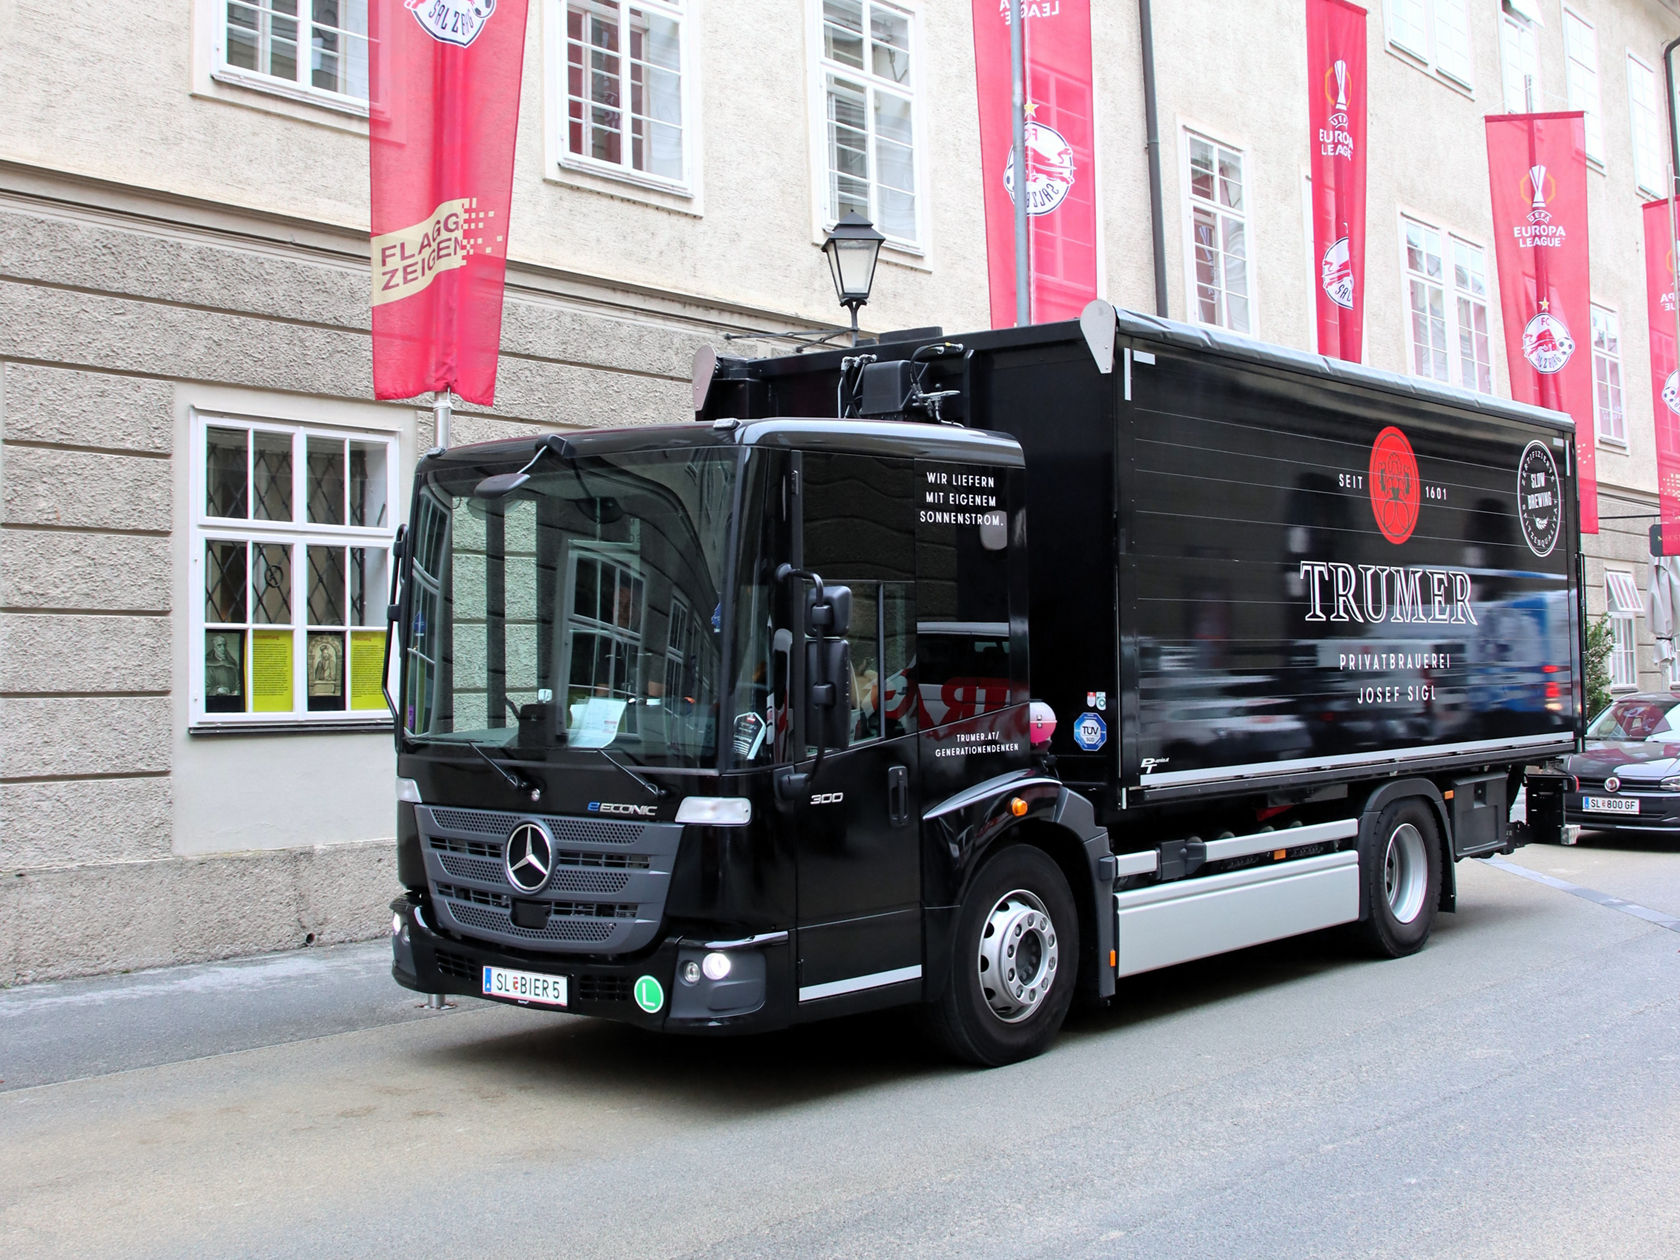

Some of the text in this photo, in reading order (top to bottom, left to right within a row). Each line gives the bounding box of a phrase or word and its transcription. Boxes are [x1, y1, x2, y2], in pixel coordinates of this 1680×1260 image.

[1513, 225, 1566, 238] EUROPA
[926, 471, 995, 488] WIR LIEFERN
[1338, 473, 1363, 489] SEIT
[1530, 471, 1546, 489] SLOW
[926, 491, 996, 507] MIT EIGENEM
[1425, 486, 1447, 500] 1601
[1527, 491, 1553, 510] BREWING
[919, 510, 1004, 527] SONNENSTROM.
[1300, 560, 1479, 626] TRUMER
[1339, 653, 1451, 670] PRIVATBRAUEREI
[1357, 685, 1436, 704] JOSEF SIGL
[935, 743, 1019, 757] GENERATIONENDENKEN
[810, 792, 844, 805] 300
[1591, 799, 1601, 808] SL
[496, 973, 561, 999] SL BIER 5
[643, 983, 656, 1007] L
